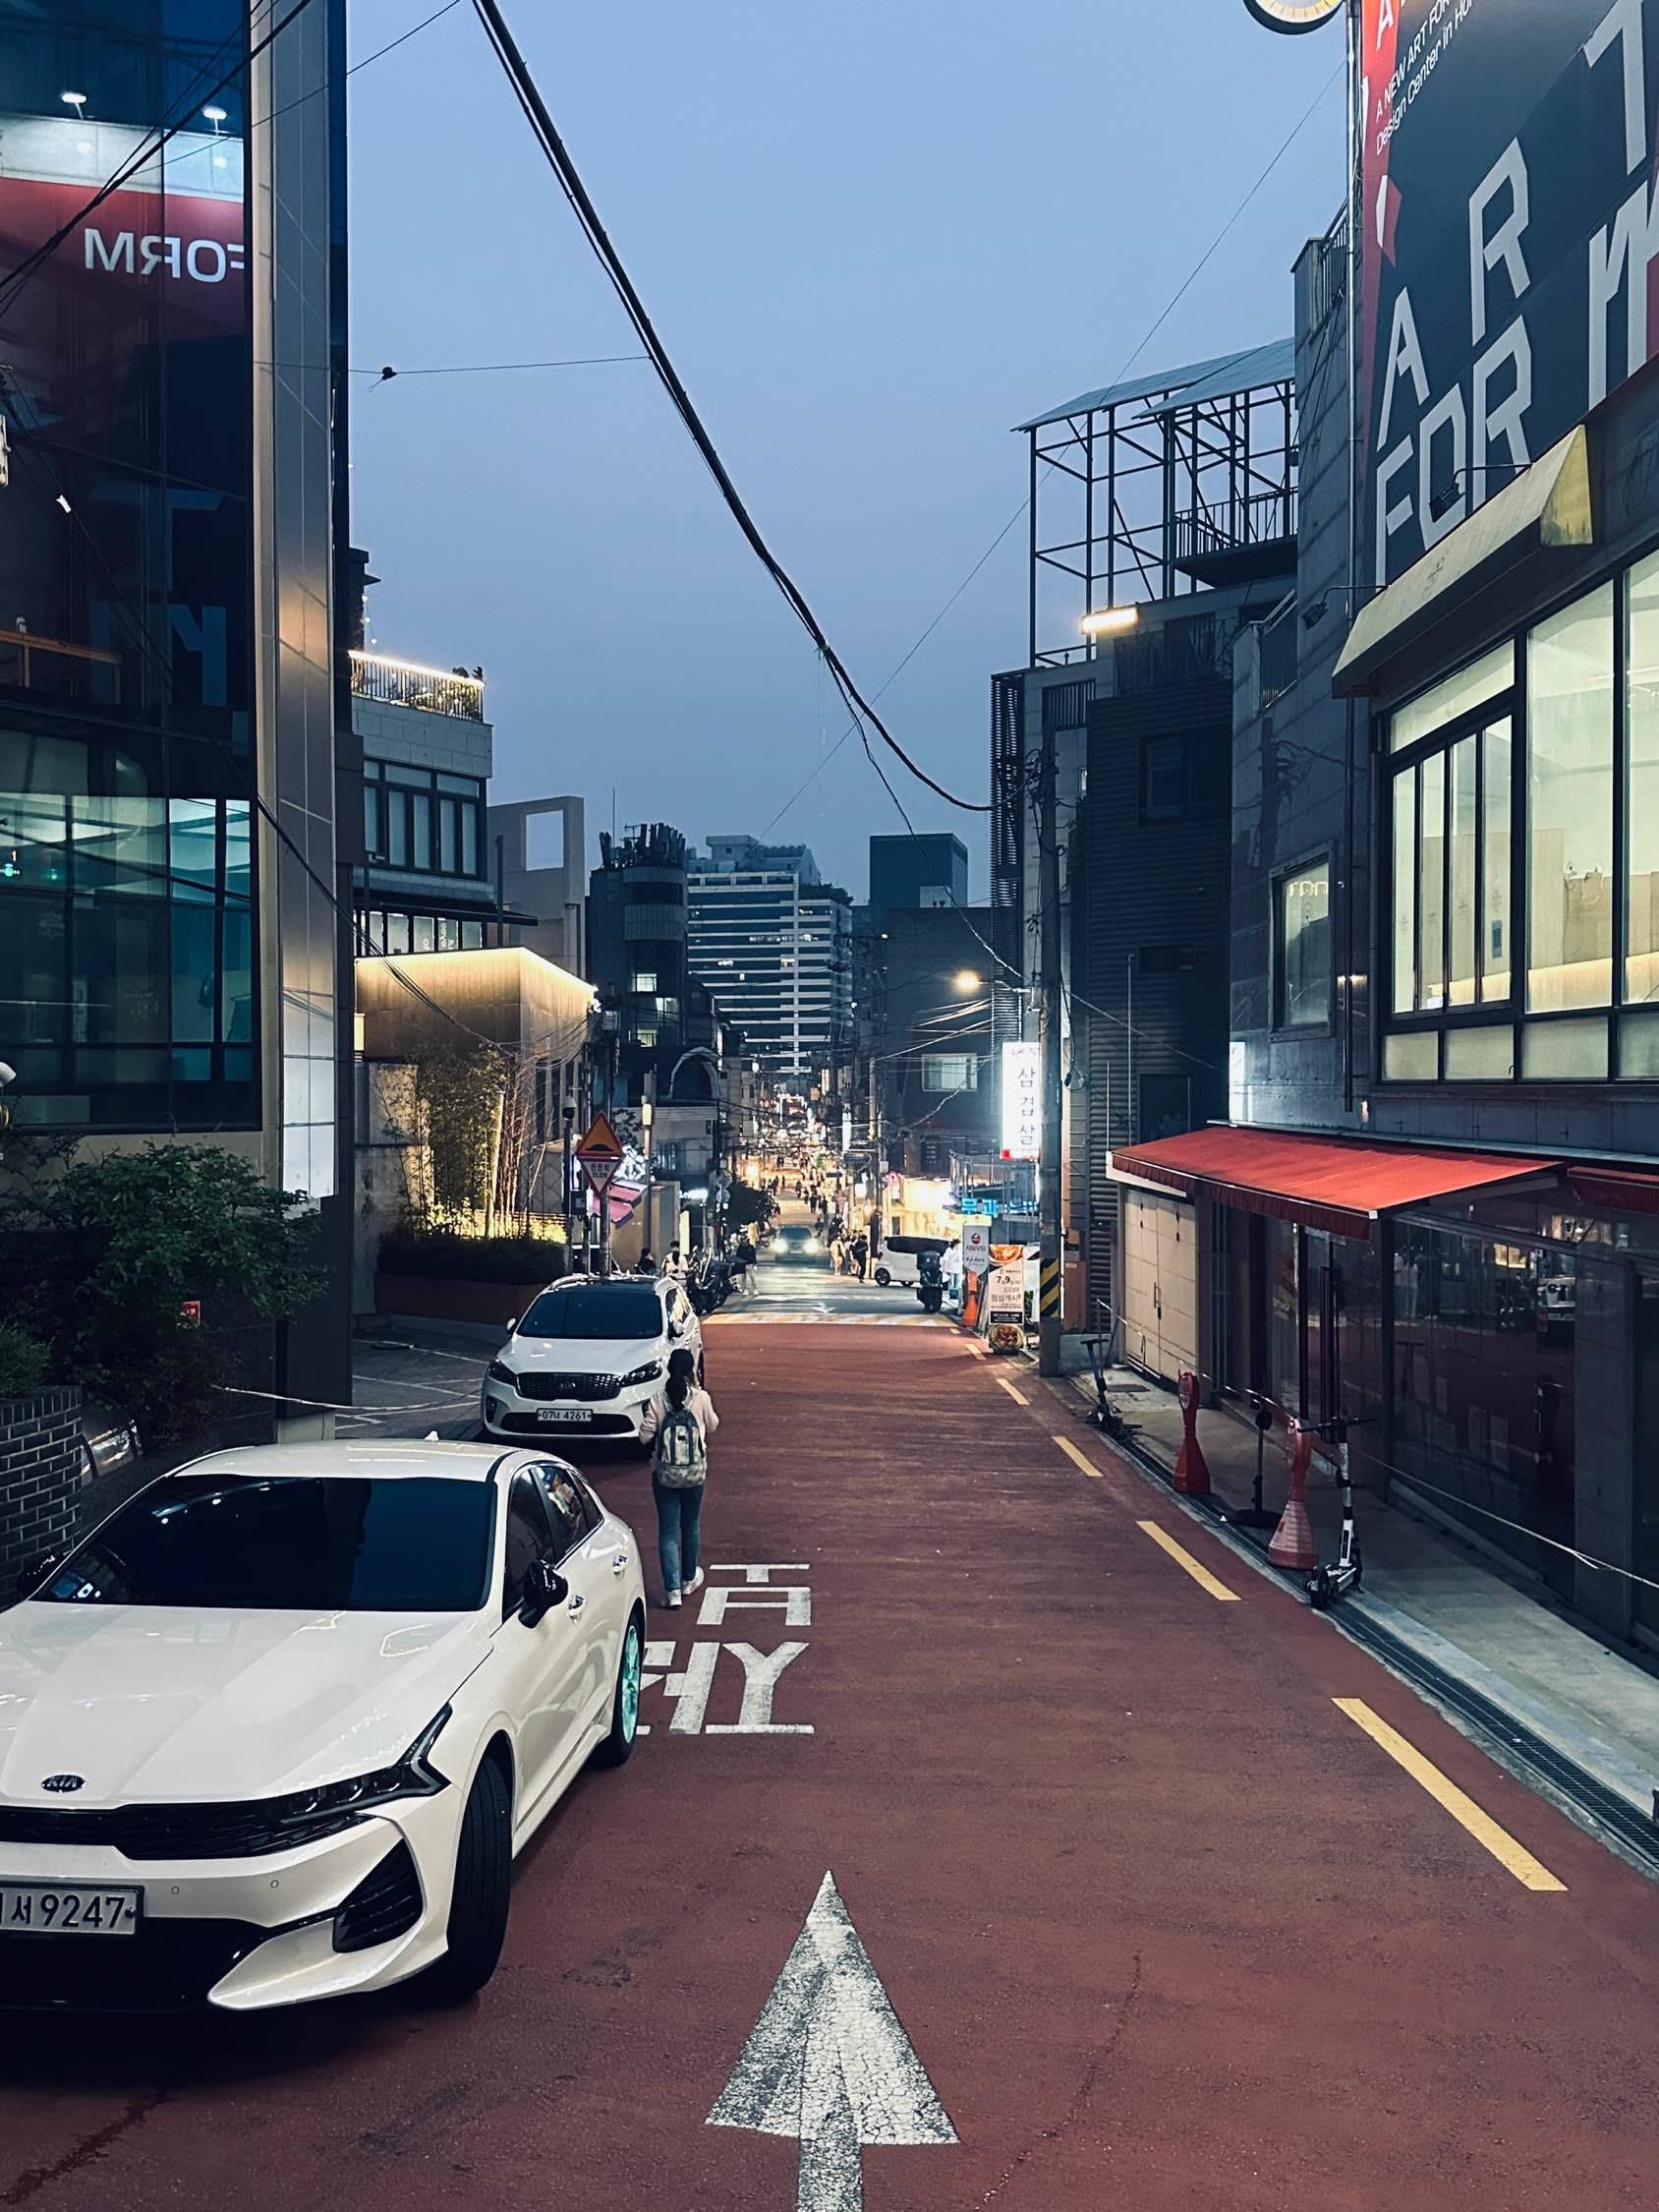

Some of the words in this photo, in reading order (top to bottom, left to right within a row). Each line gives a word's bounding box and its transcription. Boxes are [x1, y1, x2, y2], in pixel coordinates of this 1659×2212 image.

[1376, 99, 1383, 123] A
[1384, 57, 1406, 109] NEW
[1407, 20, 1428, 71] ART
[1376, 96, 1406, 156] Design
[1407, 39, 1442, 104] Center
[1443, 21, 1453, 49] in
[47, 1775, 78, 1788] KIA
[40, 1893, 126, 1929] 9247
